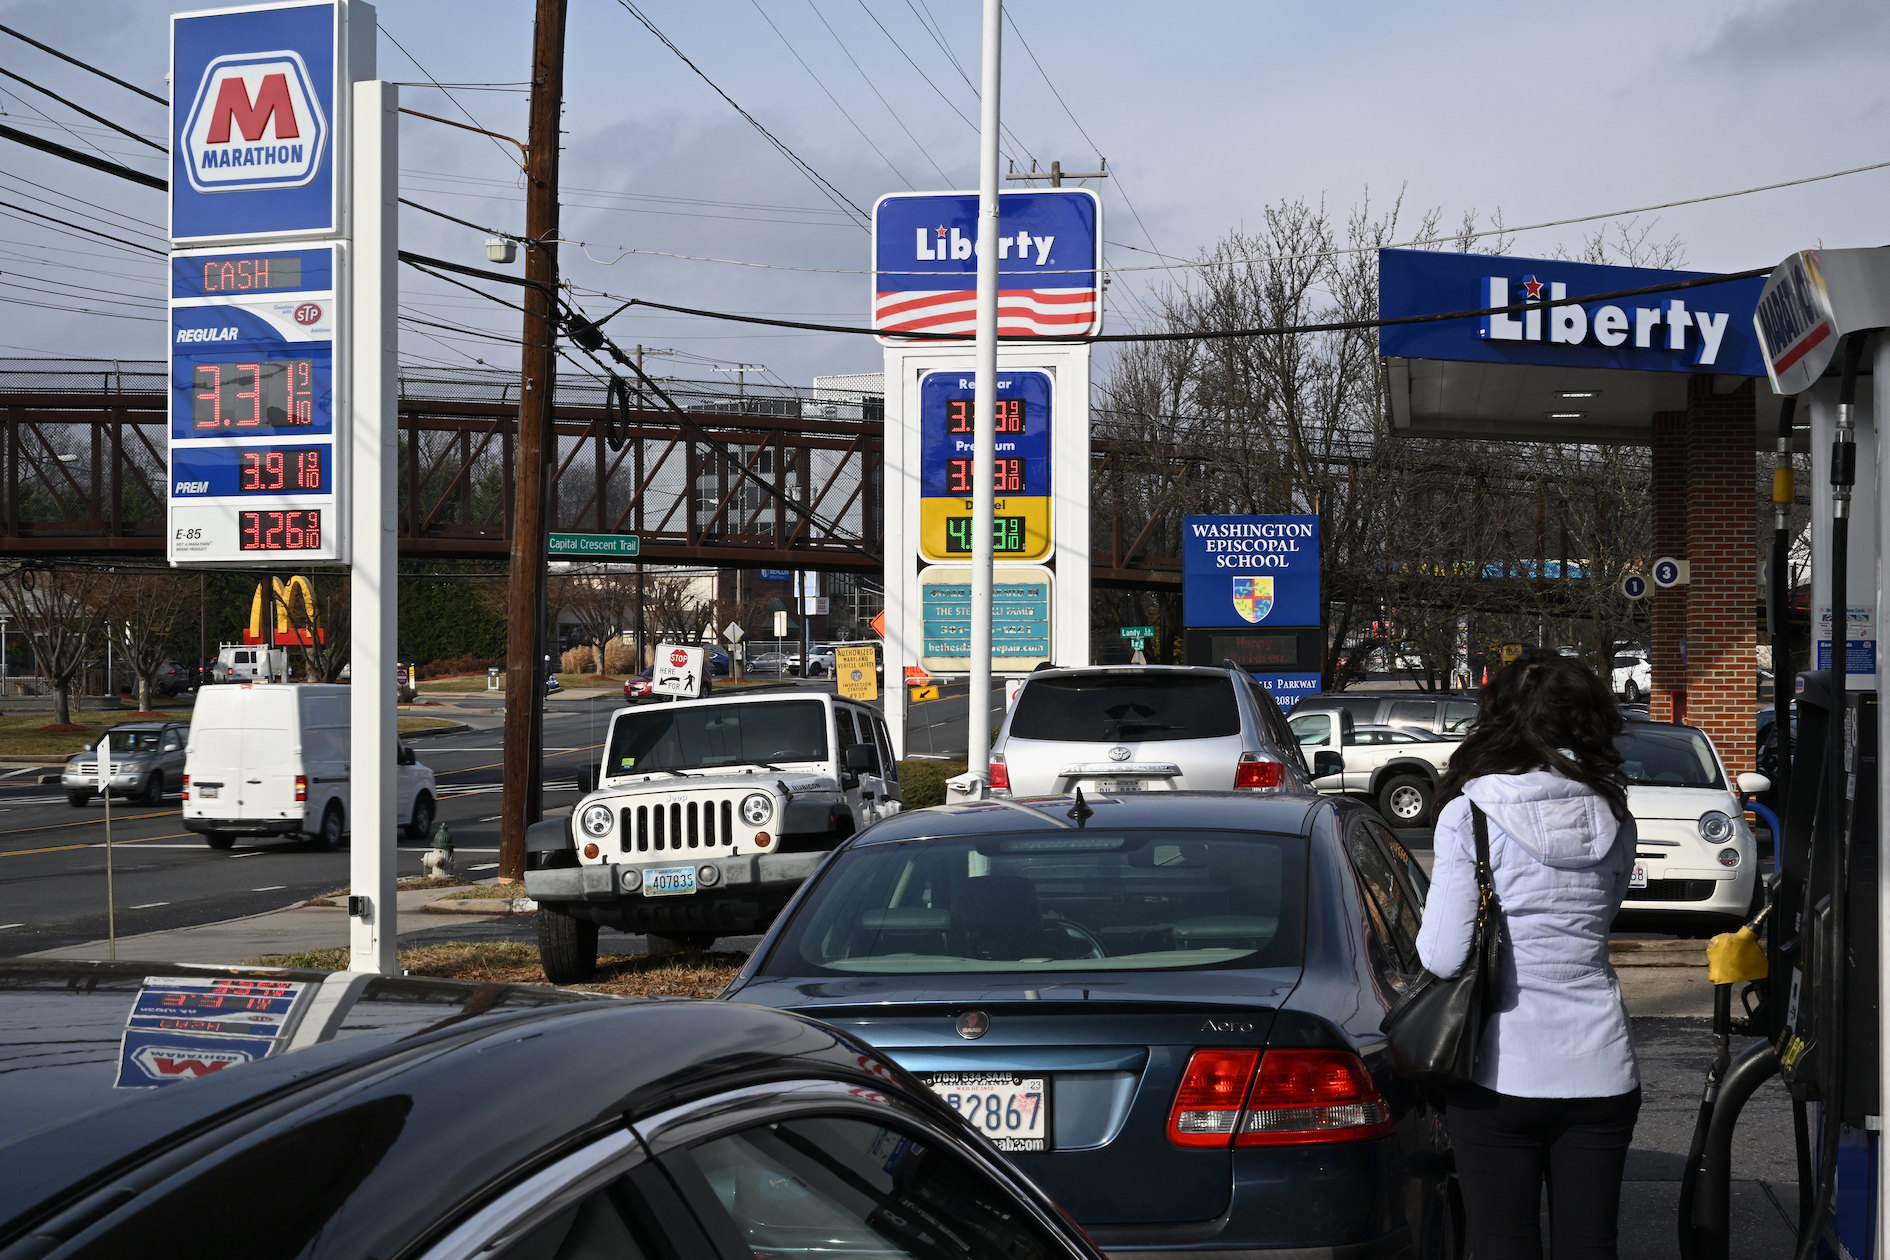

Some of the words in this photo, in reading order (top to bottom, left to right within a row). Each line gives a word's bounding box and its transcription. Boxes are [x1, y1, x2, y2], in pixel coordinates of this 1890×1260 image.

[201, 144, 303, 169] MARATHON
[916, 225, 1055, 266] Librty
[204, 259, 269, 290] CASH
[296, 305, 319, 322] STP
[1489, 274, 1730, 365] Liberty
[176, 327, 239, 343] REGULAR
[958, 379, 1013, 390] Rear
[951, 402, 1007, 433] 3.3
[955, 441, 1016, 452] Preum
[951, 460, 1007, 491] 3.3
[175, 481, 209, 494] PREM
[965, 500, 1006, 511] Del
[175, 528, 202, 540] E-85
[244, 512, 304, 549] 3.26
[949, 519, 1007, 550] 4.3
[1192, 524, 1313, 537] WASHINGTON
[549, 538, 578, 551] Capital
[580, 539, 617, 551] Crescent
[619, 540, 636, 551] Trail
[1206, 540, 1299, 552] EPISCOPAL
[1216, 555, 1289, 568] SCHOOL
[1662, 565, 1672, 580] 3
[1632, 581, 1638, 593] 1
[936, 607, 953, 616] THE
[1121, 629, 1141, 637] Landy
[1236, 637, 1273, 650] Happy
[837, 648, 874, 656] AUTHORIZED
[670, 654, 688, 663] STOP
[659, 667, 676, 675] HERE
[668, 682, 681, 690] FOR
[1277, 679, 1316, 689] PARKWAY
[792, 782, 821, 791] RUBICON
[666, 794, 688, 802] Jeep
[1200, 1020, 1253, 1032] Aero
[933, 1072, 960, 1083] (703)
[962, 1072, 1013, 1083] 534-SAAB
[1030, 1080, 1041, 1090] 23
